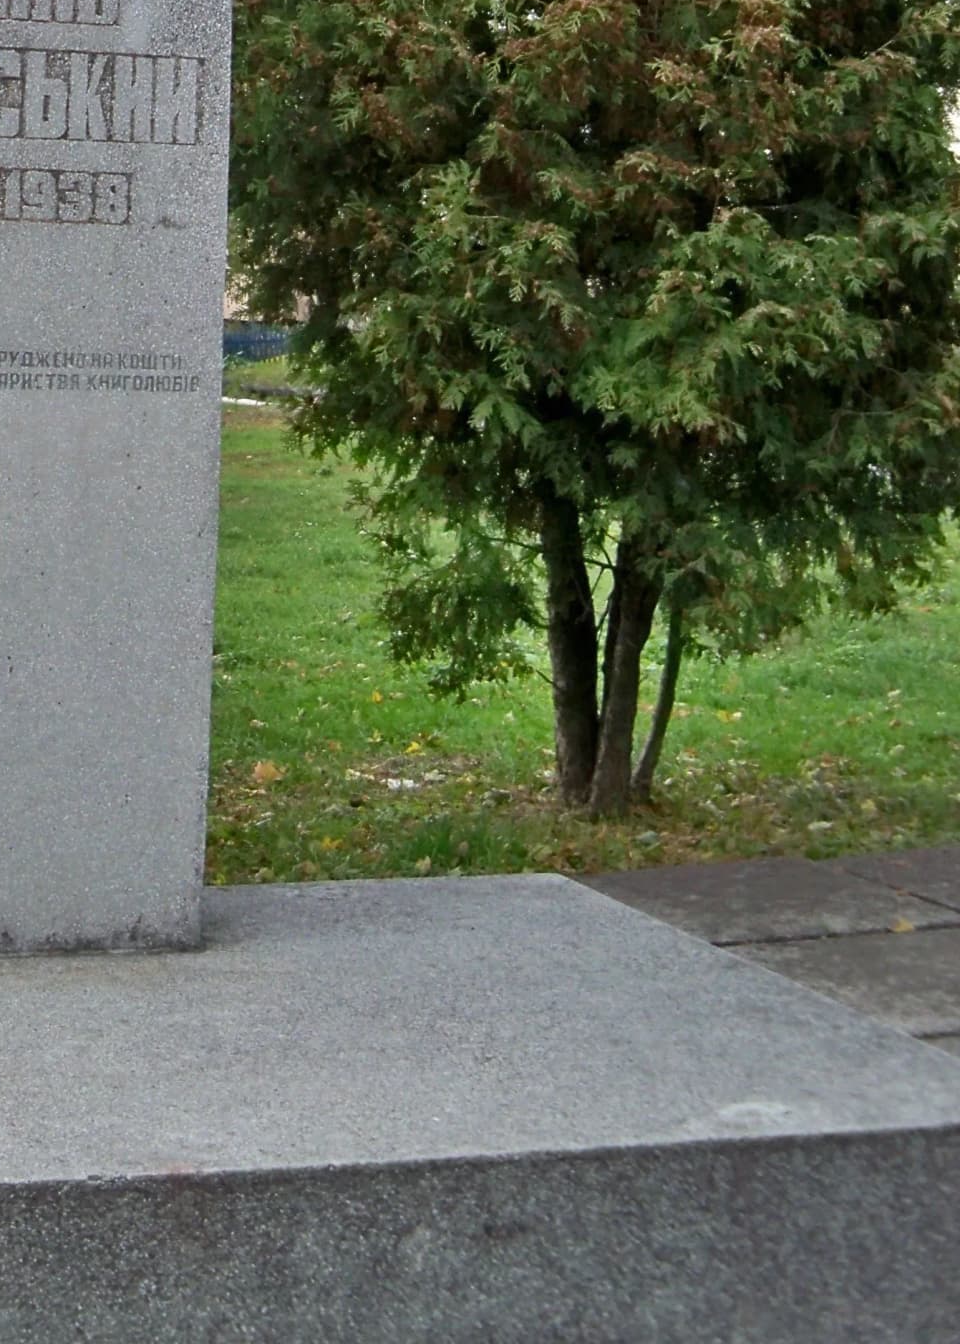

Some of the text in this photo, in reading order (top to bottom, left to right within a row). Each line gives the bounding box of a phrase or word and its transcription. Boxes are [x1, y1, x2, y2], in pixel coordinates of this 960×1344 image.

[90, 352, 113, 369] НА
[117, 353, 183, 371] КОШТИ
[87, 373, 201, 393] КНИГОЛЮБІВ
